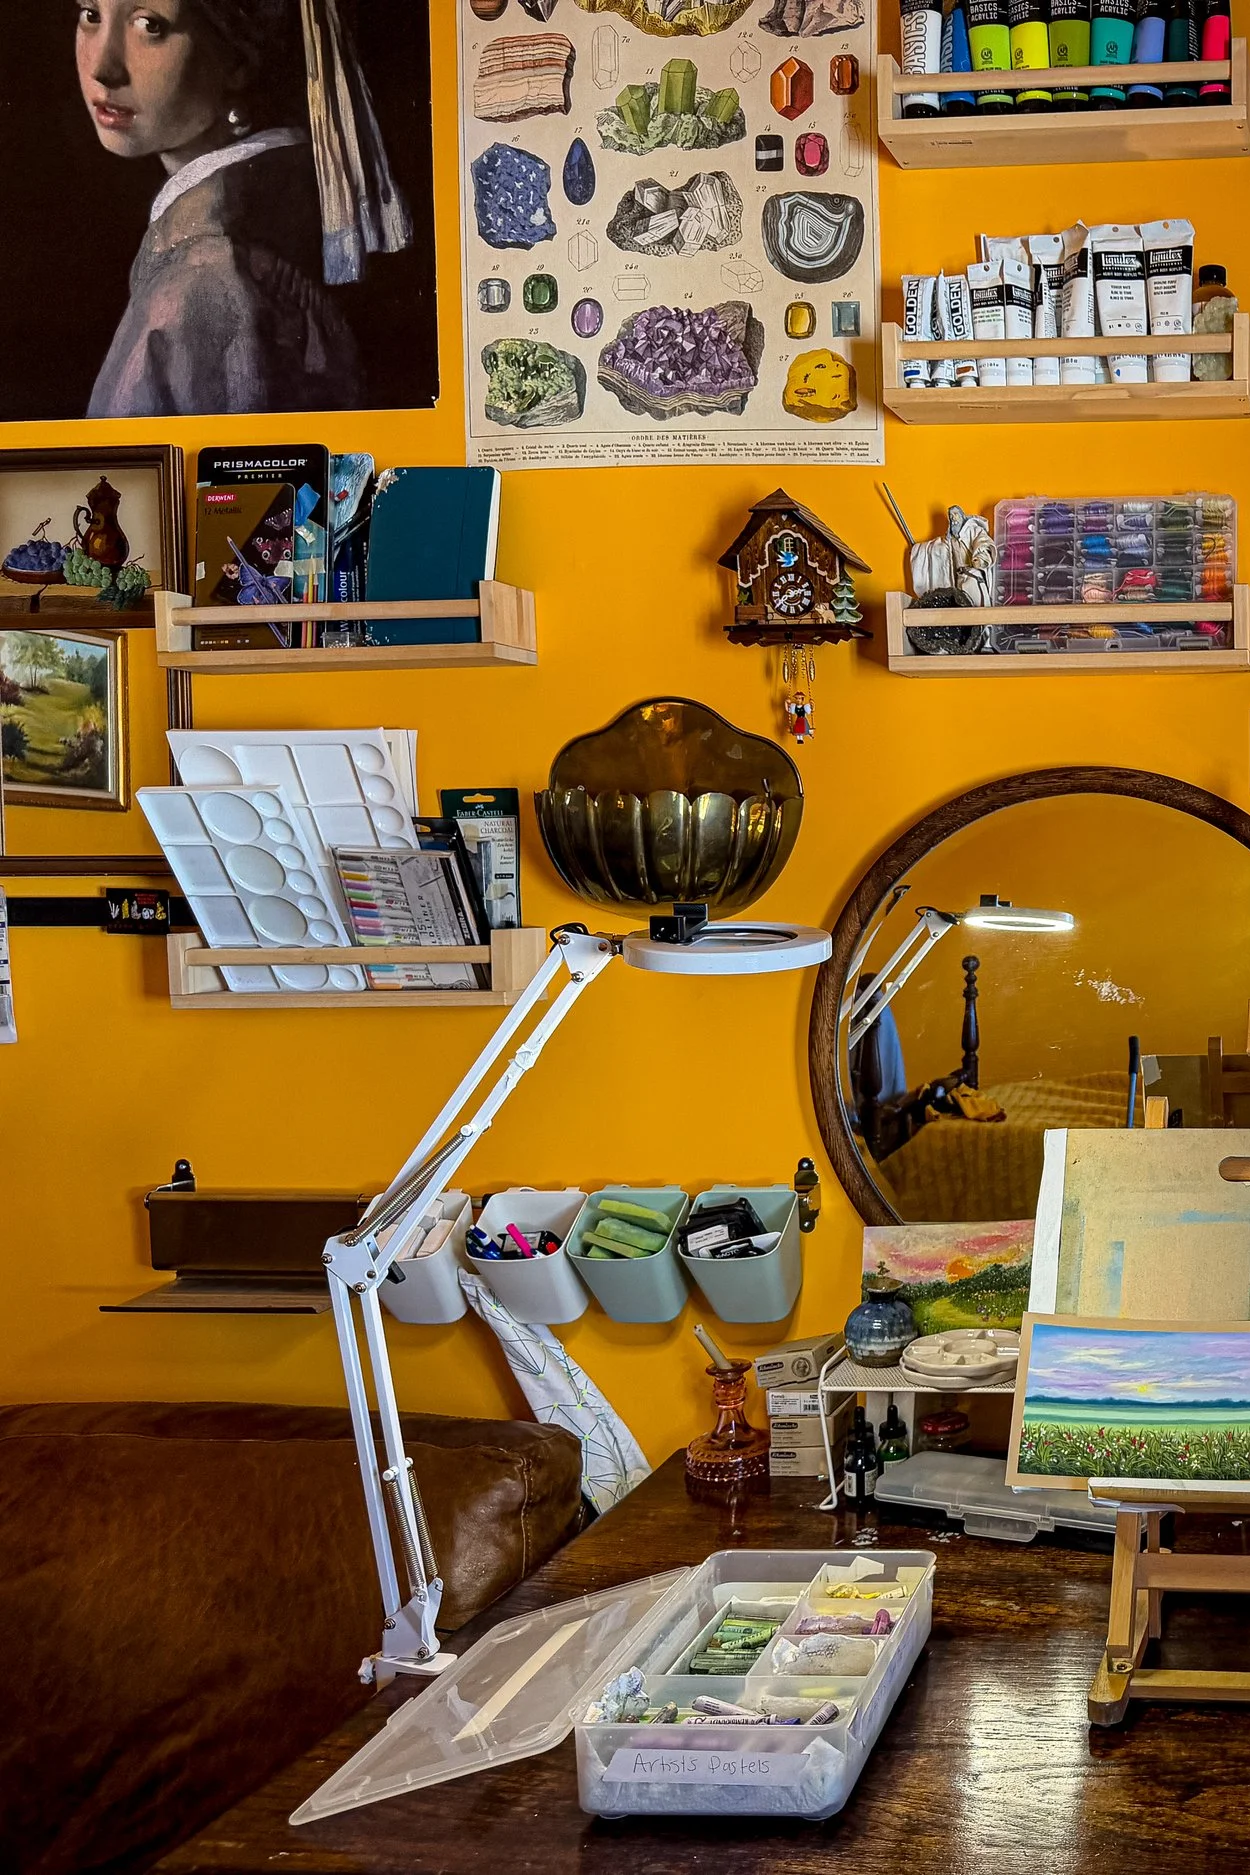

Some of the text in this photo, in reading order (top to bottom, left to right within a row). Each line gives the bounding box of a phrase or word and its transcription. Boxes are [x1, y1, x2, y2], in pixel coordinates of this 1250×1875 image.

[970, 3, 998, 14] BASICS
[1050, 6, 1076, 16] ACRYLIC
[1100, 6, 1128, 16] ACRYLIC
[970, 12, 998, 22] ACRYLIC
[1102, 253, 1136, 267] Liquitex
[1150, 250, 1182, 264] Liquitex
[905, 280, 919, 335] GOLDEN
[950, 282, 965, 337] GOLDEN
[214, 459, 306, 468] PRISMACOLOR
[456, 809, 503, 817] FABER-CASTELL
[418, 895, 437, 944] LDLINER
[457, 907, 470, 939] ZEBRA
[710, 1756, 770, 1774] Pastels
